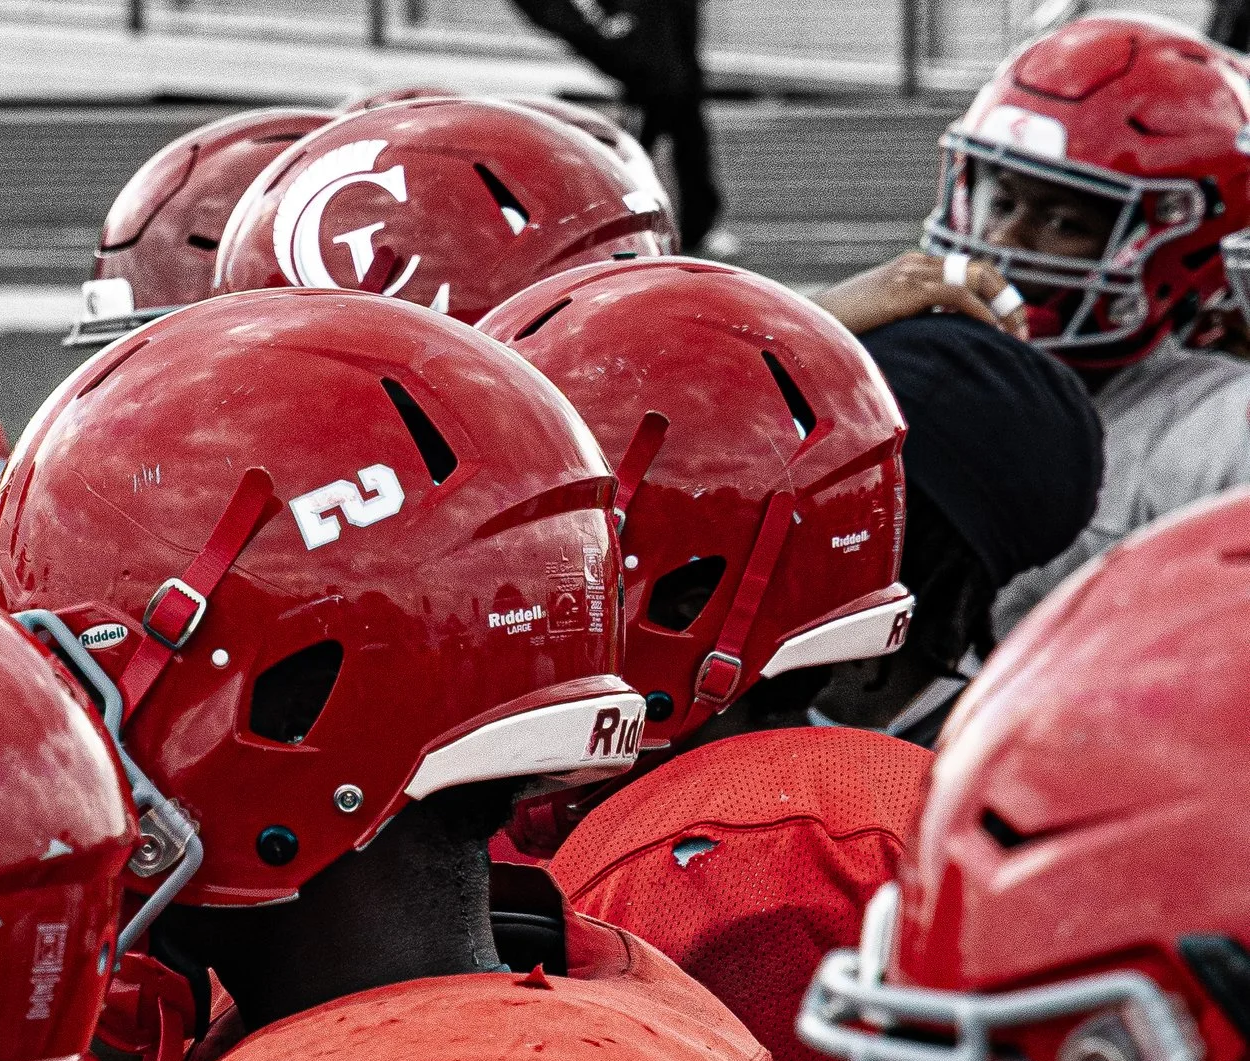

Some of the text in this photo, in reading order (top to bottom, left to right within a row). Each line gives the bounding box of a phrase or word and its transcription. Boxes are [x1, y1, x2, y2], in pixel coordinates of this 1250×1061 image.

[832, 529, 868, 549] Riddell
[488, 604, 543, 628] Riddell
[81, 626, 125, 647] Riddell
[507, 622, 532, 635] LARGE
